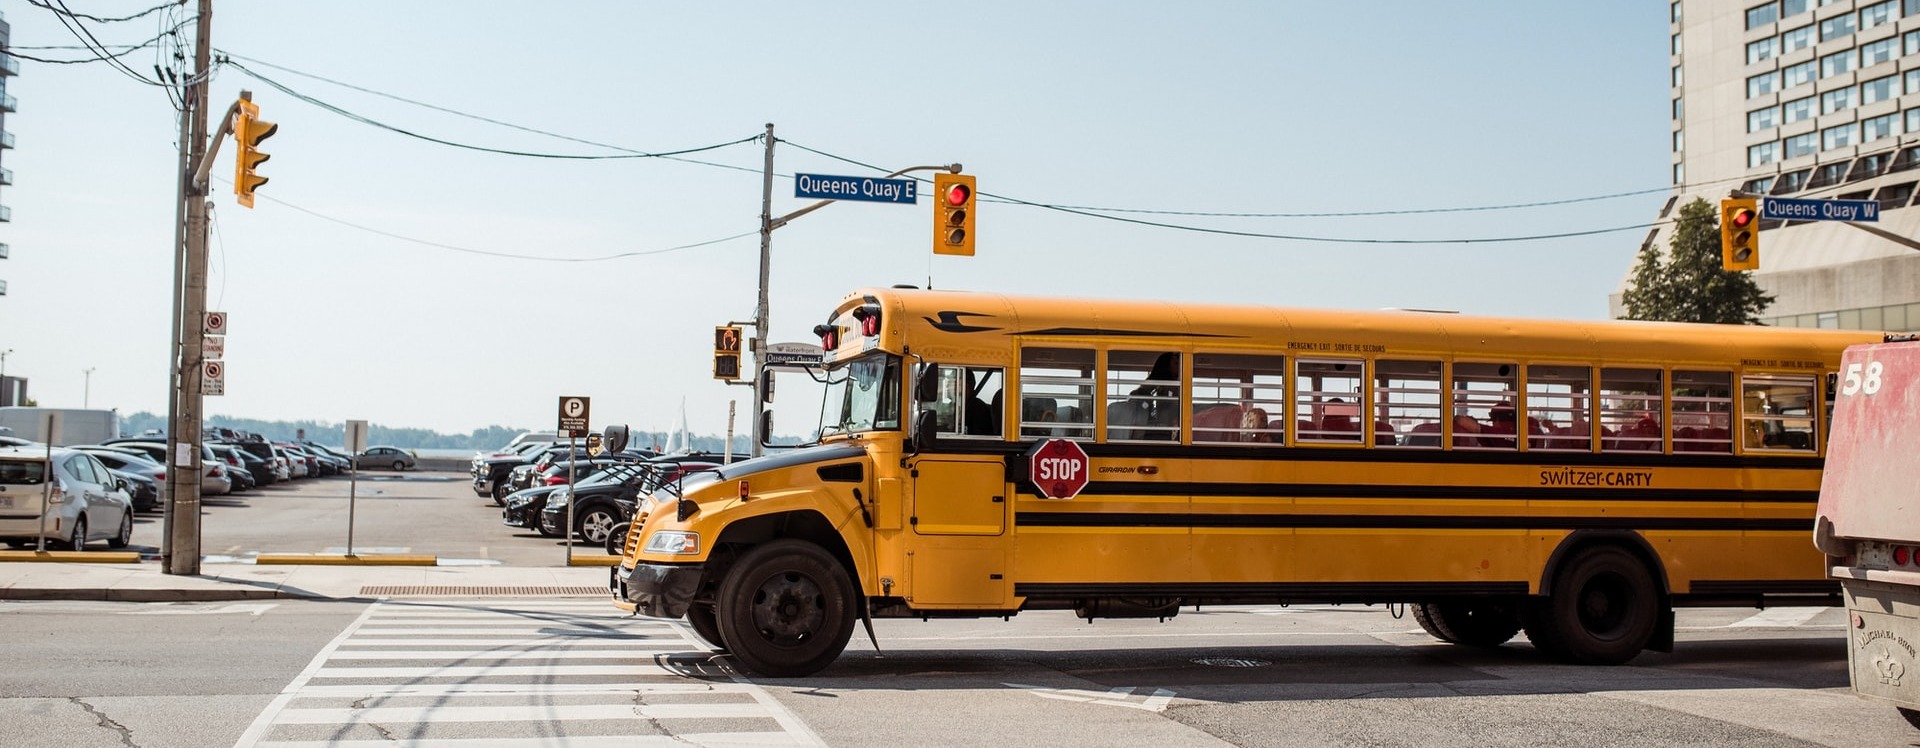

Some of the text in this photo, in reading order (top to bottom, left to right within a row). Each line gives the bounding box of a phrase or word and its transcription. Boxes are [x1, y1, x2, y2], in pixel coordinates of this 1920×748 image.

[800, 175, 914, 201] Queens Quay E
[1768, 200, 1875, 221] Queens Quay W
[1287, 342, 1386, 353] EMERGENCY EXIT SORTIE DE SECOURS
[1843, 361, 1883, 397] 58
[571, 402, 579, 413] P
[1040, 458, 1081, 481] STOP
[1098, 466, 1136, 474] GIRARDIN
